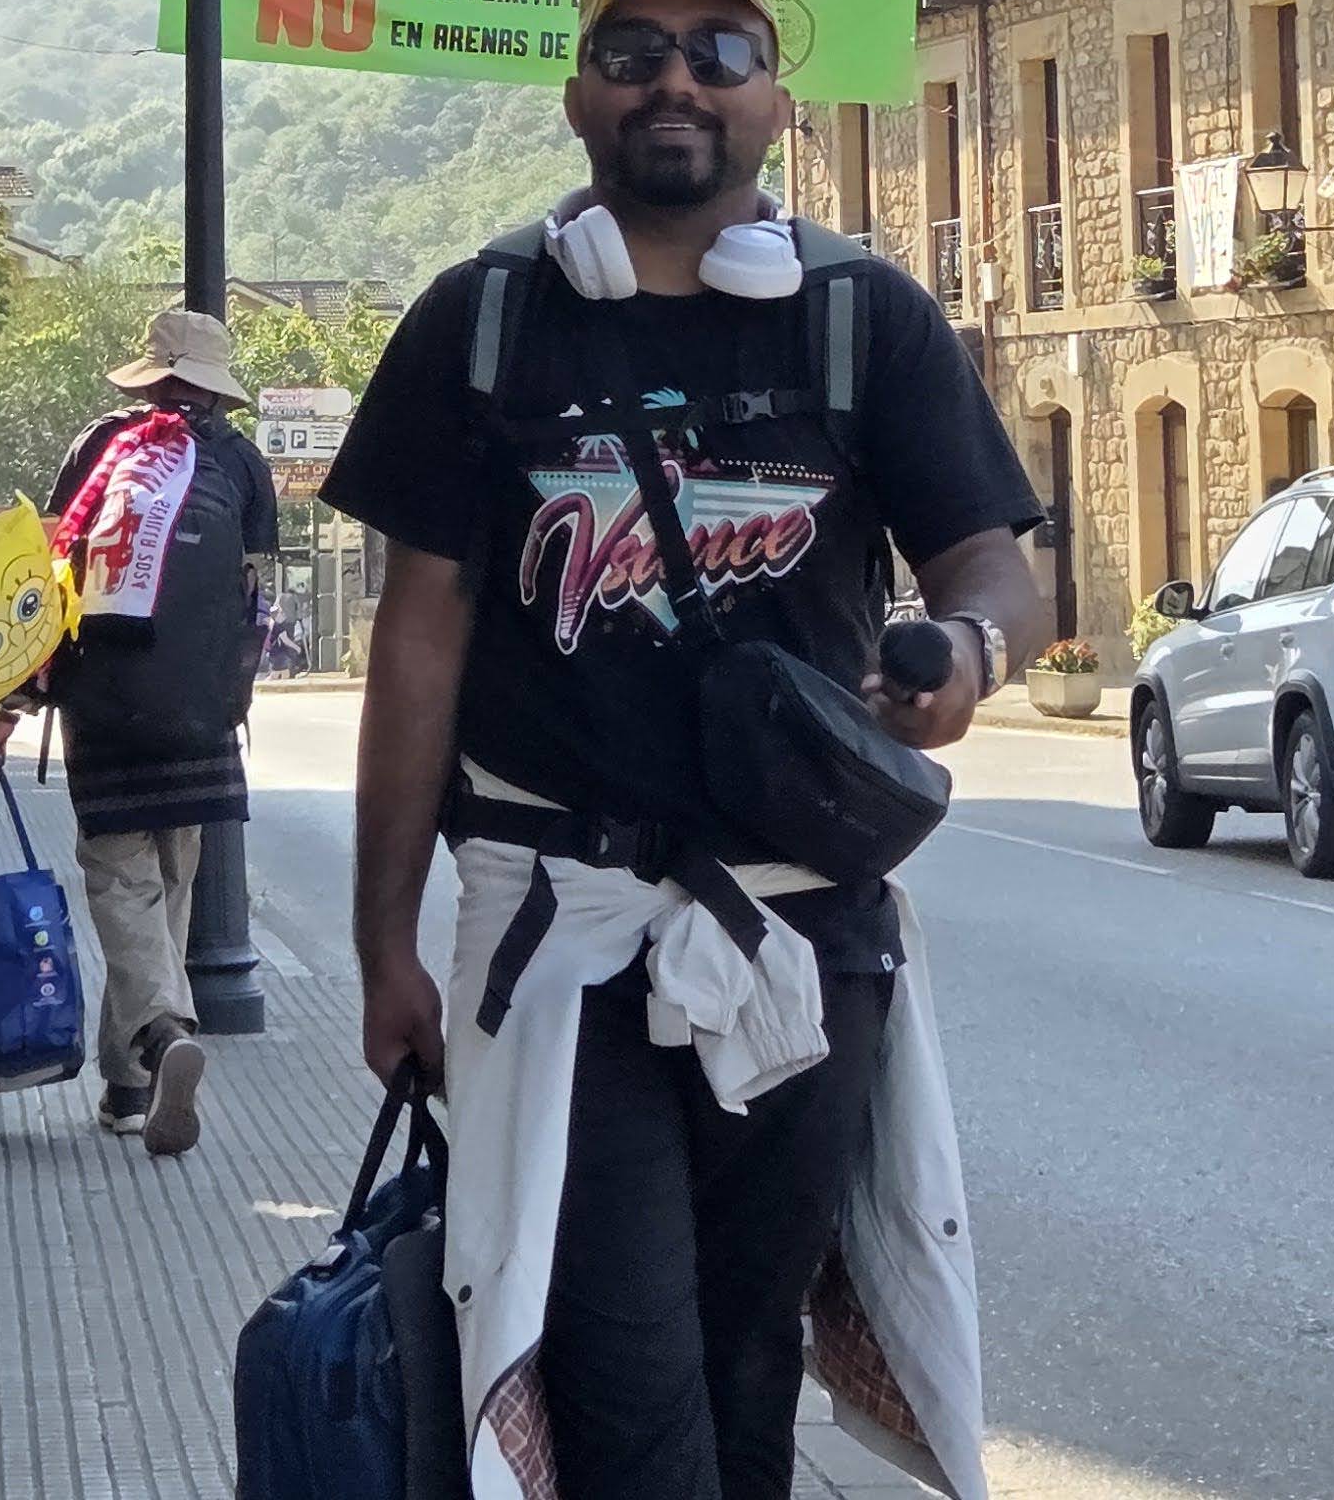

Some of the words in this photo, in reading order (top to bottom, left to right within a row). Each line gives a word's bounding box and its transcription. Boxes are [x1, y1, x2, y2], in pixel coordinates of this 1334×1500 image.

[390, 20, 424, 49] EN
[433, 23, 529, 57] ARENAS
[539, 31, 571, 60] DE
